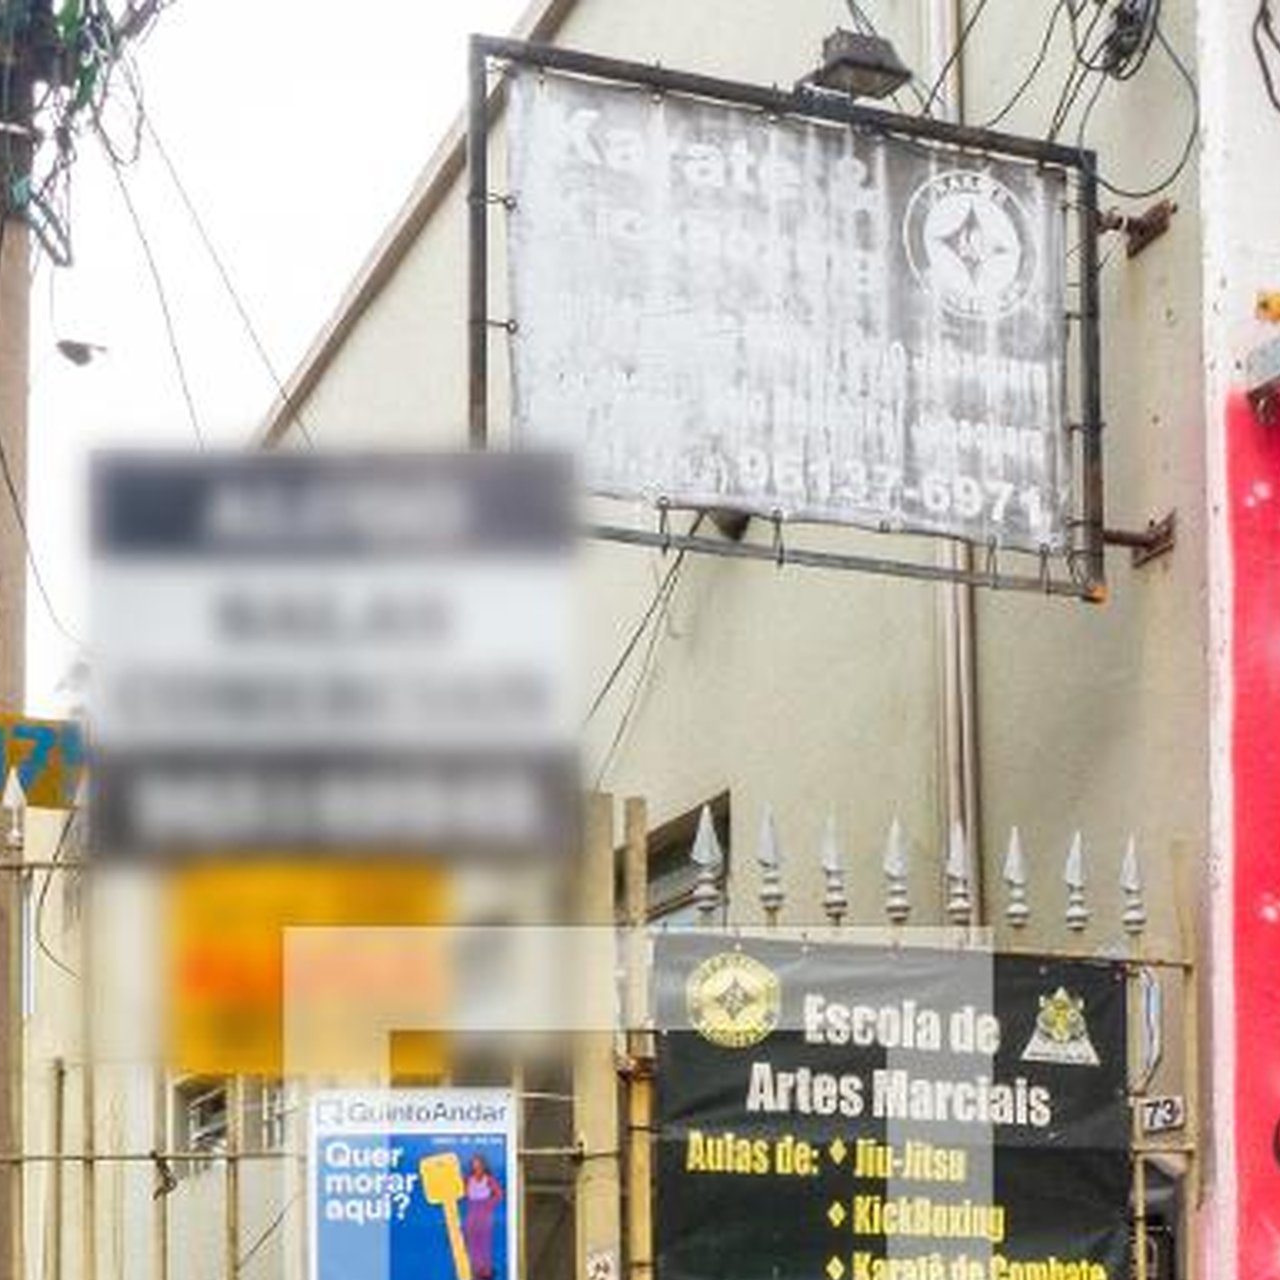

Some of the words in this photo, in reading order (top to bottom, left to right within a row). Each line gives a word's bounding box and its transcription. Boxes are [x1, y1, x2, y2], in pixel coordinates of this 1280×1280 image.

[803, 993, 943, 1052] Escola
[949, 1005, 1001, 1055] de
[347, 1102, 507, 1123] QuintoAndar
[746, 1062, 864, 1117] Artes
[872, 1068, 1052, 1127] Marciais
[325, 1141, 405, 1168] Quer
[686, 1130, 770, 1175] Aulas
[775, 1134, 820, 1176] de:
[853, 1139, 967, 1182] Jiu-Jitsu
[325, 1171, 419, 1195] morar
[325, 1193, 412, 1226] aqui?
[853, 1195, 1005, 1243] KickBoxing
